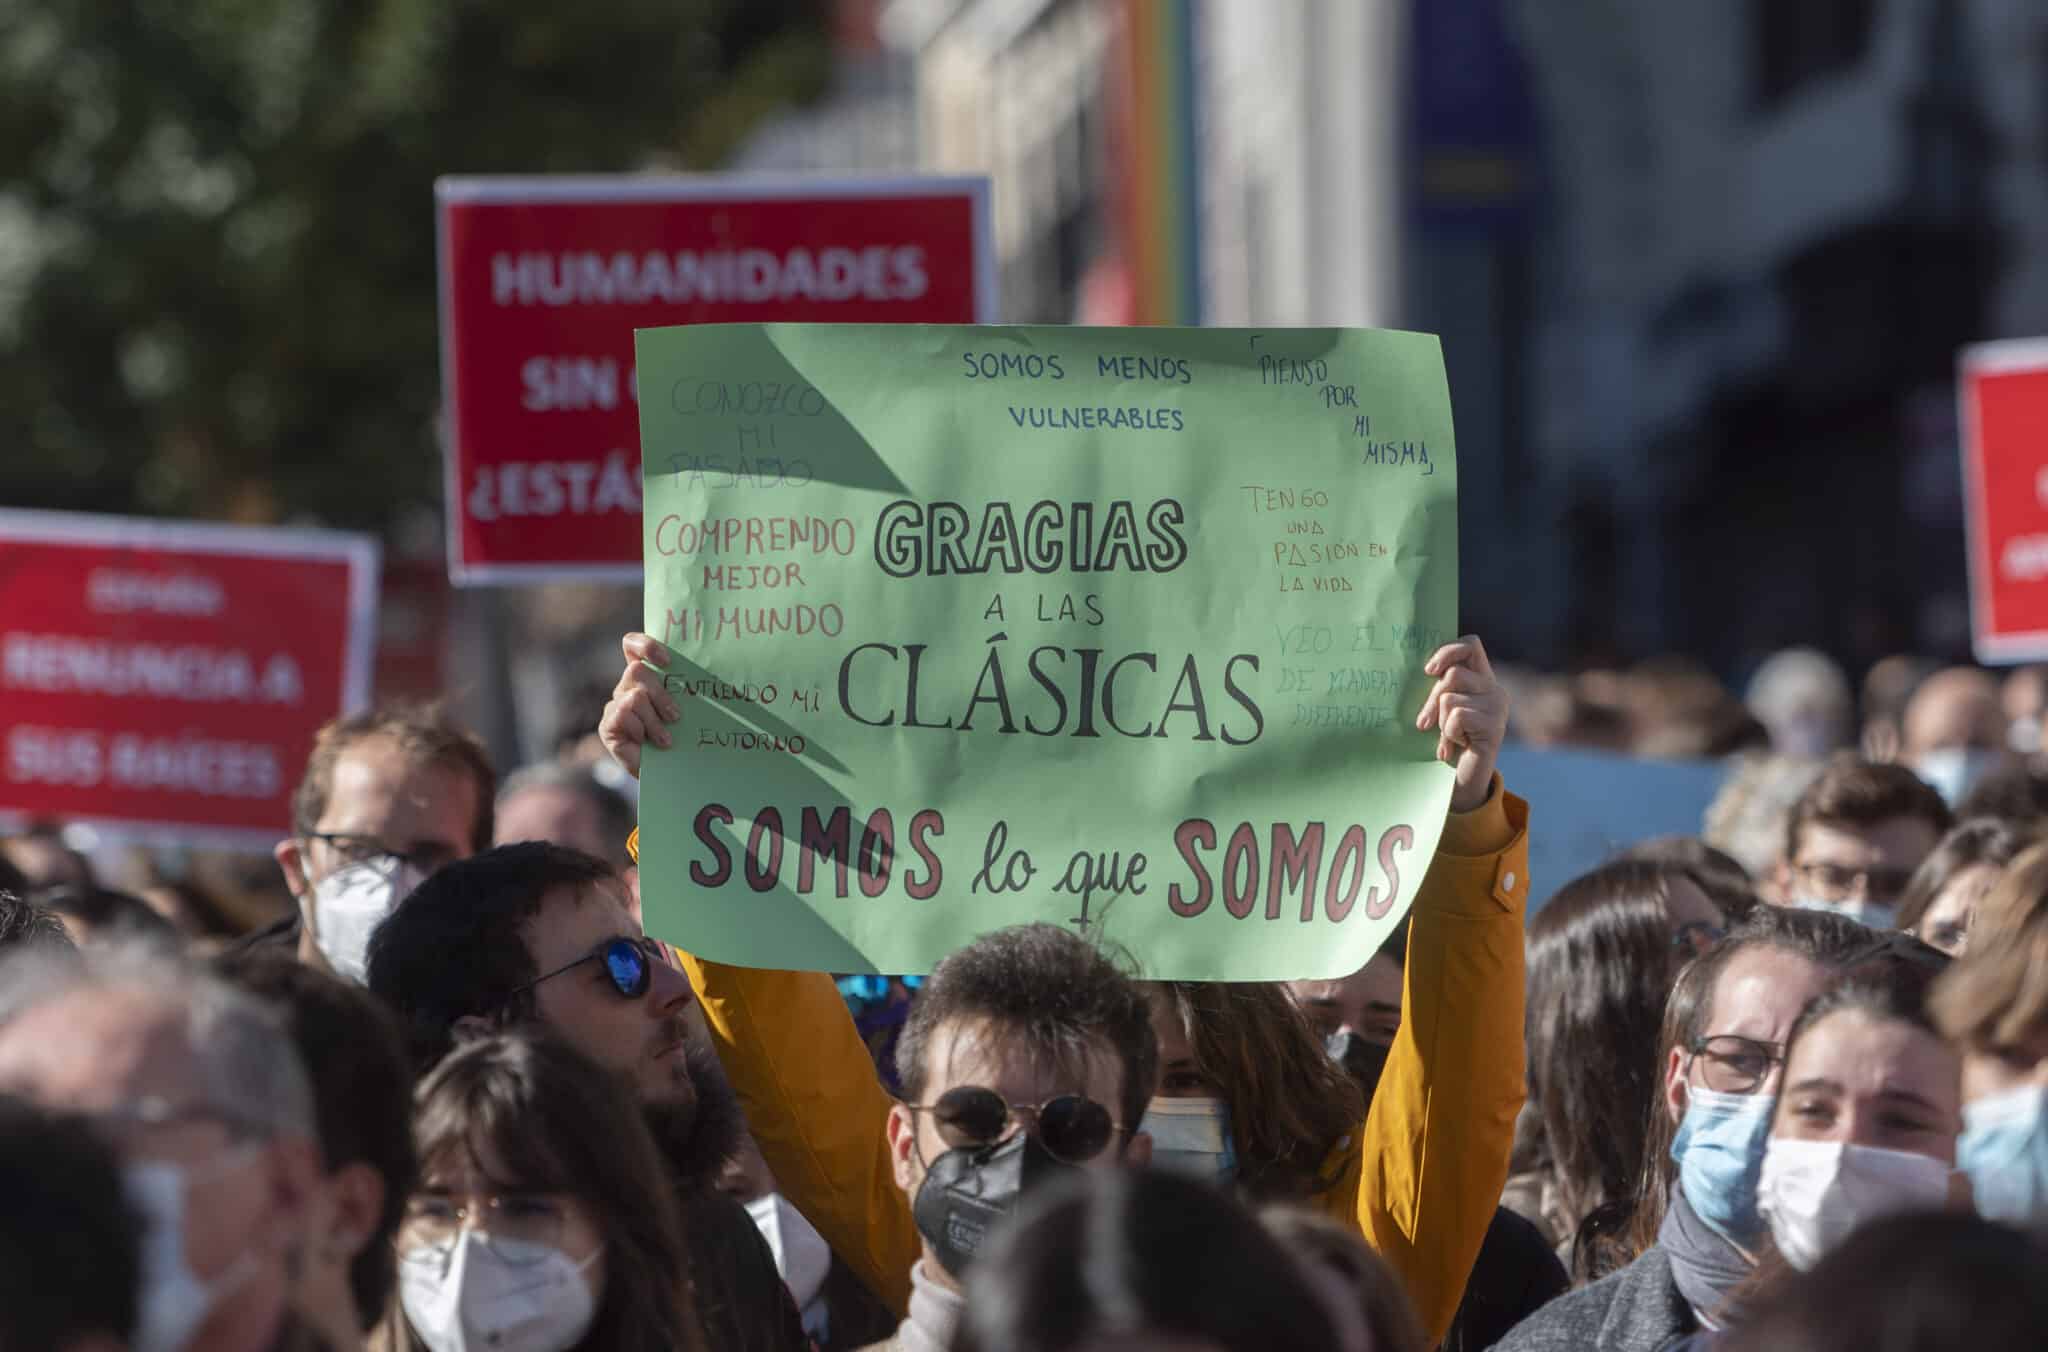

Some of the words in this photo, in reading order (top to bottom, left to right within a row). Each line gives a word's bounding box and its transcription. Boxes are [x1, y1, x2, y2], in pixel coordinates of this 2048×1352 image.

[490, 245, 927, 307] HUMANIDADES
[520, 354, 618, 414] SIN
[963, 352, 1065, 380] SOMOS
[1098, 355, 1192, 385] MENOS
[1258, 354, 1328, 387] PIENSO
[672, 376, 825, 417] CONOZCO
[1320, 384, 1360, 408] POR
[1008, 406, 1185, 432] VULNERABLES
[736, 423, 777, 453] MI
[469, 447, 643, 522] ¿ESTÁ
[664, 451, 813, 493] PASADO
[1240, 485, 1329, 513] TENGO
[656, 514, 855, 556] COMPRENDO
[874, 498, 1188, 578] GRACIAS
[1287, 520, 1325, 535] UNA
[703, 562, 806, 591] MEJOR
[1279, 573, 1304, 592] LA
[1313, 575, 1353, 592] VIDA
[664, 608, 701, 646] MI
[716, 603, 844, 640] MUNDO
[983, 593, 1005, 622] A
[1038, 594, 1104, 626] LAS
[1276, 624, 1333, 657] VEO
[1352, 624, 1385, 652] EL
[664, 673, 777, 704] ENTIENDO
[838, 632, 1264, 746] CLÁSICAS
[1277, 668, 1315, 694] DE
[699, 728, 805, 754] ENTORNO
[689, 803, 946, 900] SOMOS
[972, 820, 1037, 894] lo
[1052, 850, 1147, 935] que
[1168, 818, 1414, 923] SOMOS
